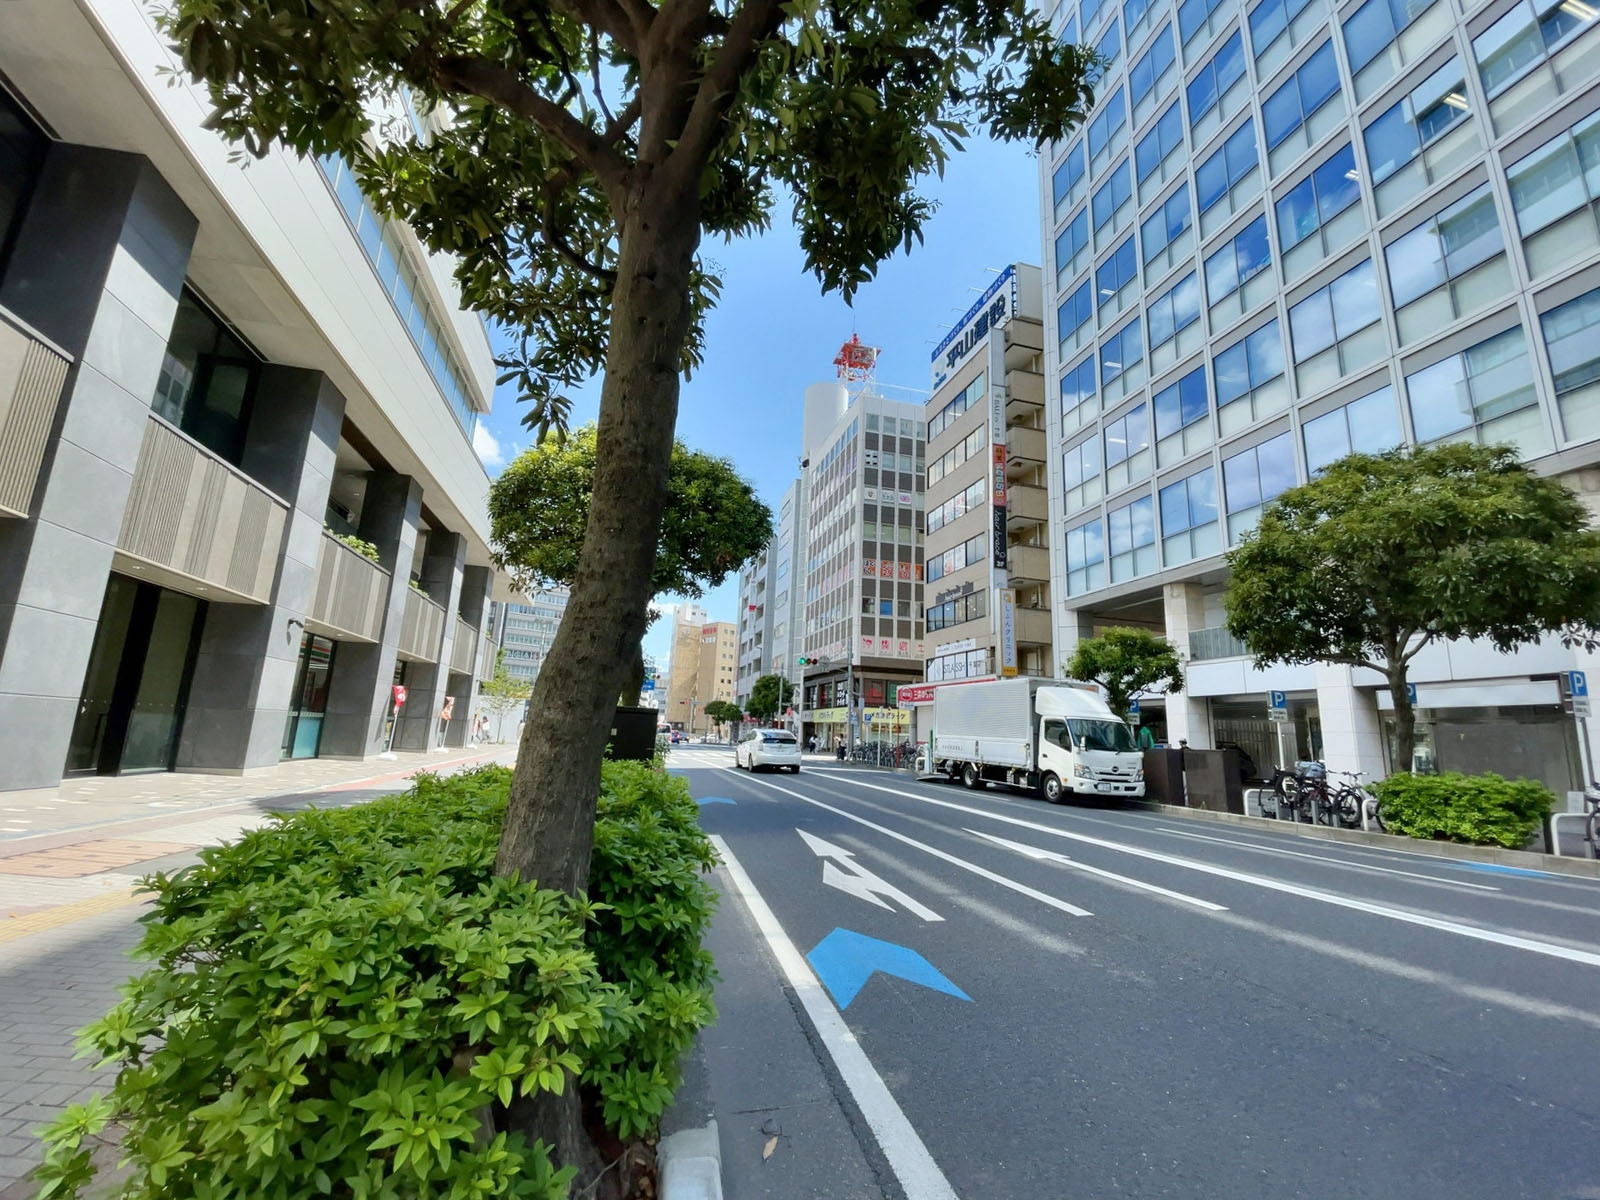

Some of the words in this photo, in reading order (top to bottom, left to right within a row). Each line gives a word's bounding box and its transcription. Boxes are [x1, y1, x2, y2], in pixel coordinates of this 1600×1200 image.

[946, 293, 1006, 368] 平山建設
[1573, 673, 1584, 694] P
[1274, 691, 1284, 707] P
